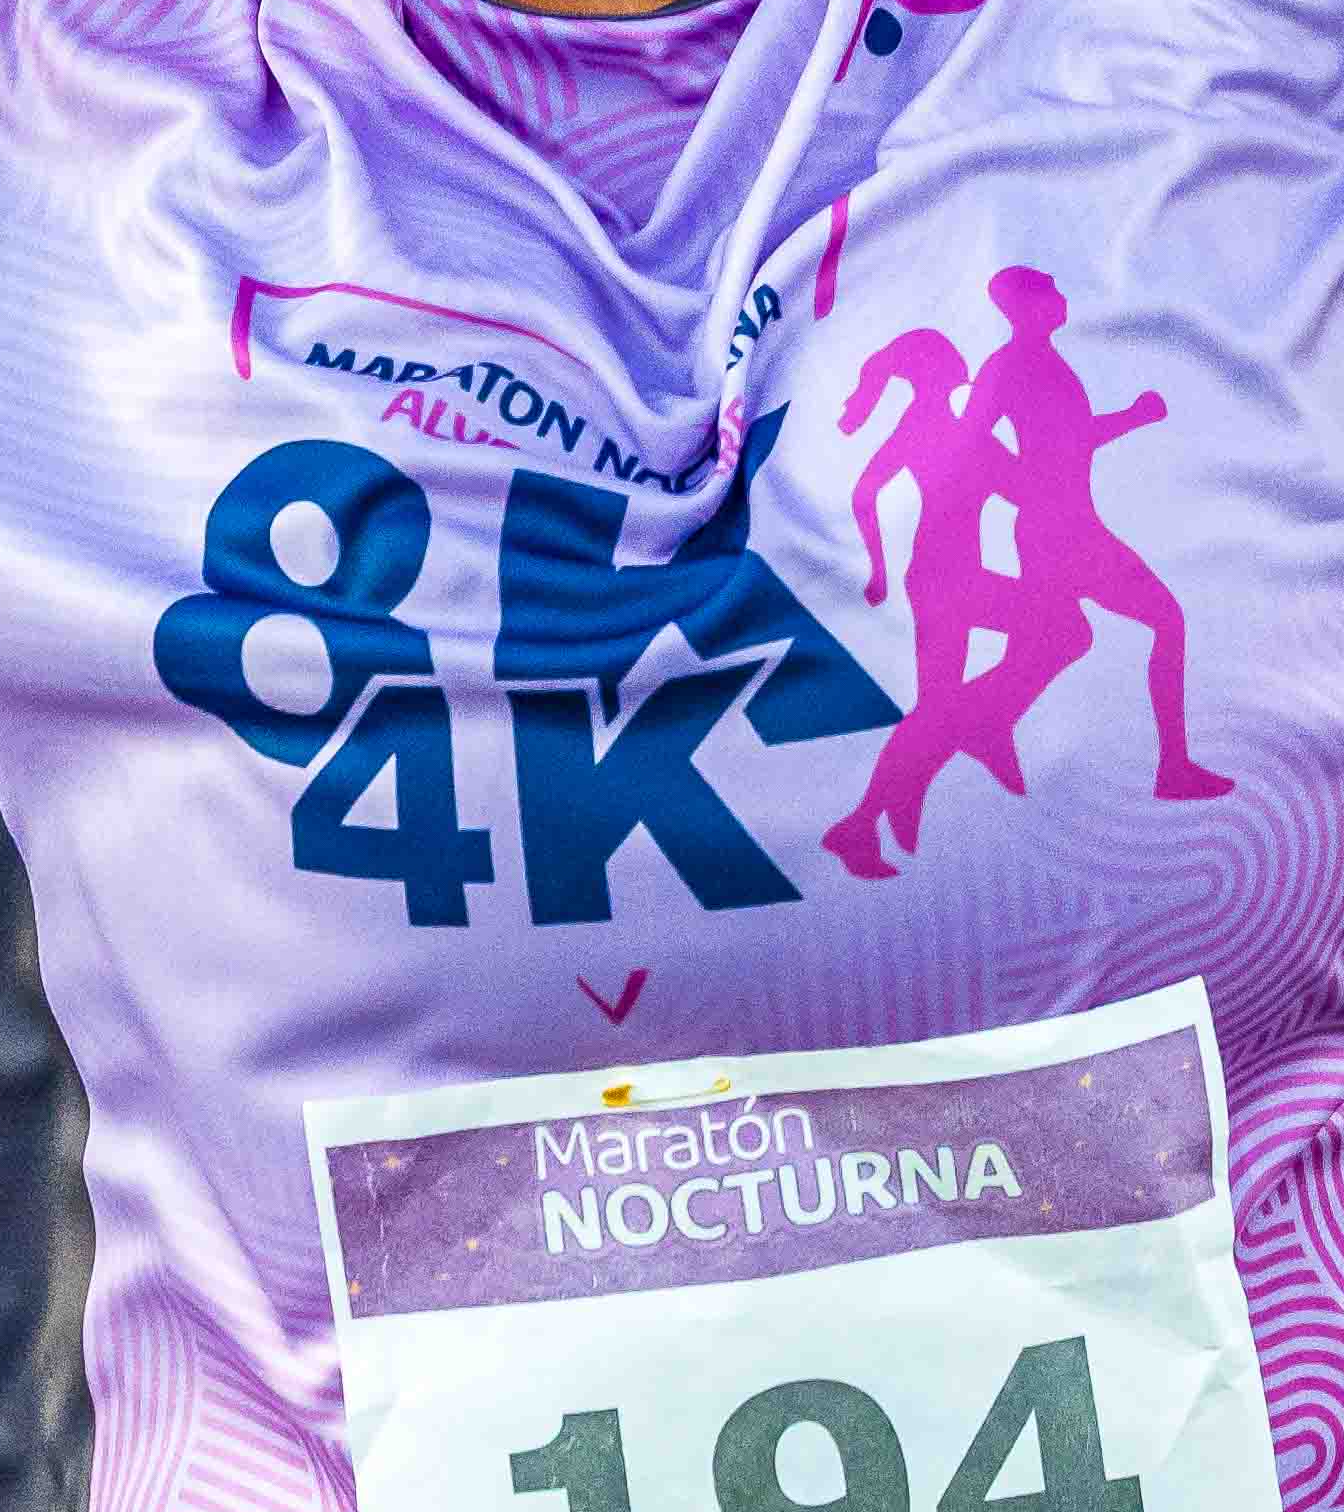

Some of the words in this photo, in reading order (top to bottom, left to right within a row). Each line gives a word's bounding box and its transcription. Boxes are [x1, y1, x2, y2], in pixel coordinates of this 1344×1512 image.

[305, 342, 586, 452] MARATON
[154, 400, 904, 766] 8K
[292, 682, 804, 926] 4K
[534, 1094, 814, 1181] Maratón
[542, 1142, 1022, 1255] NOCTURNA
